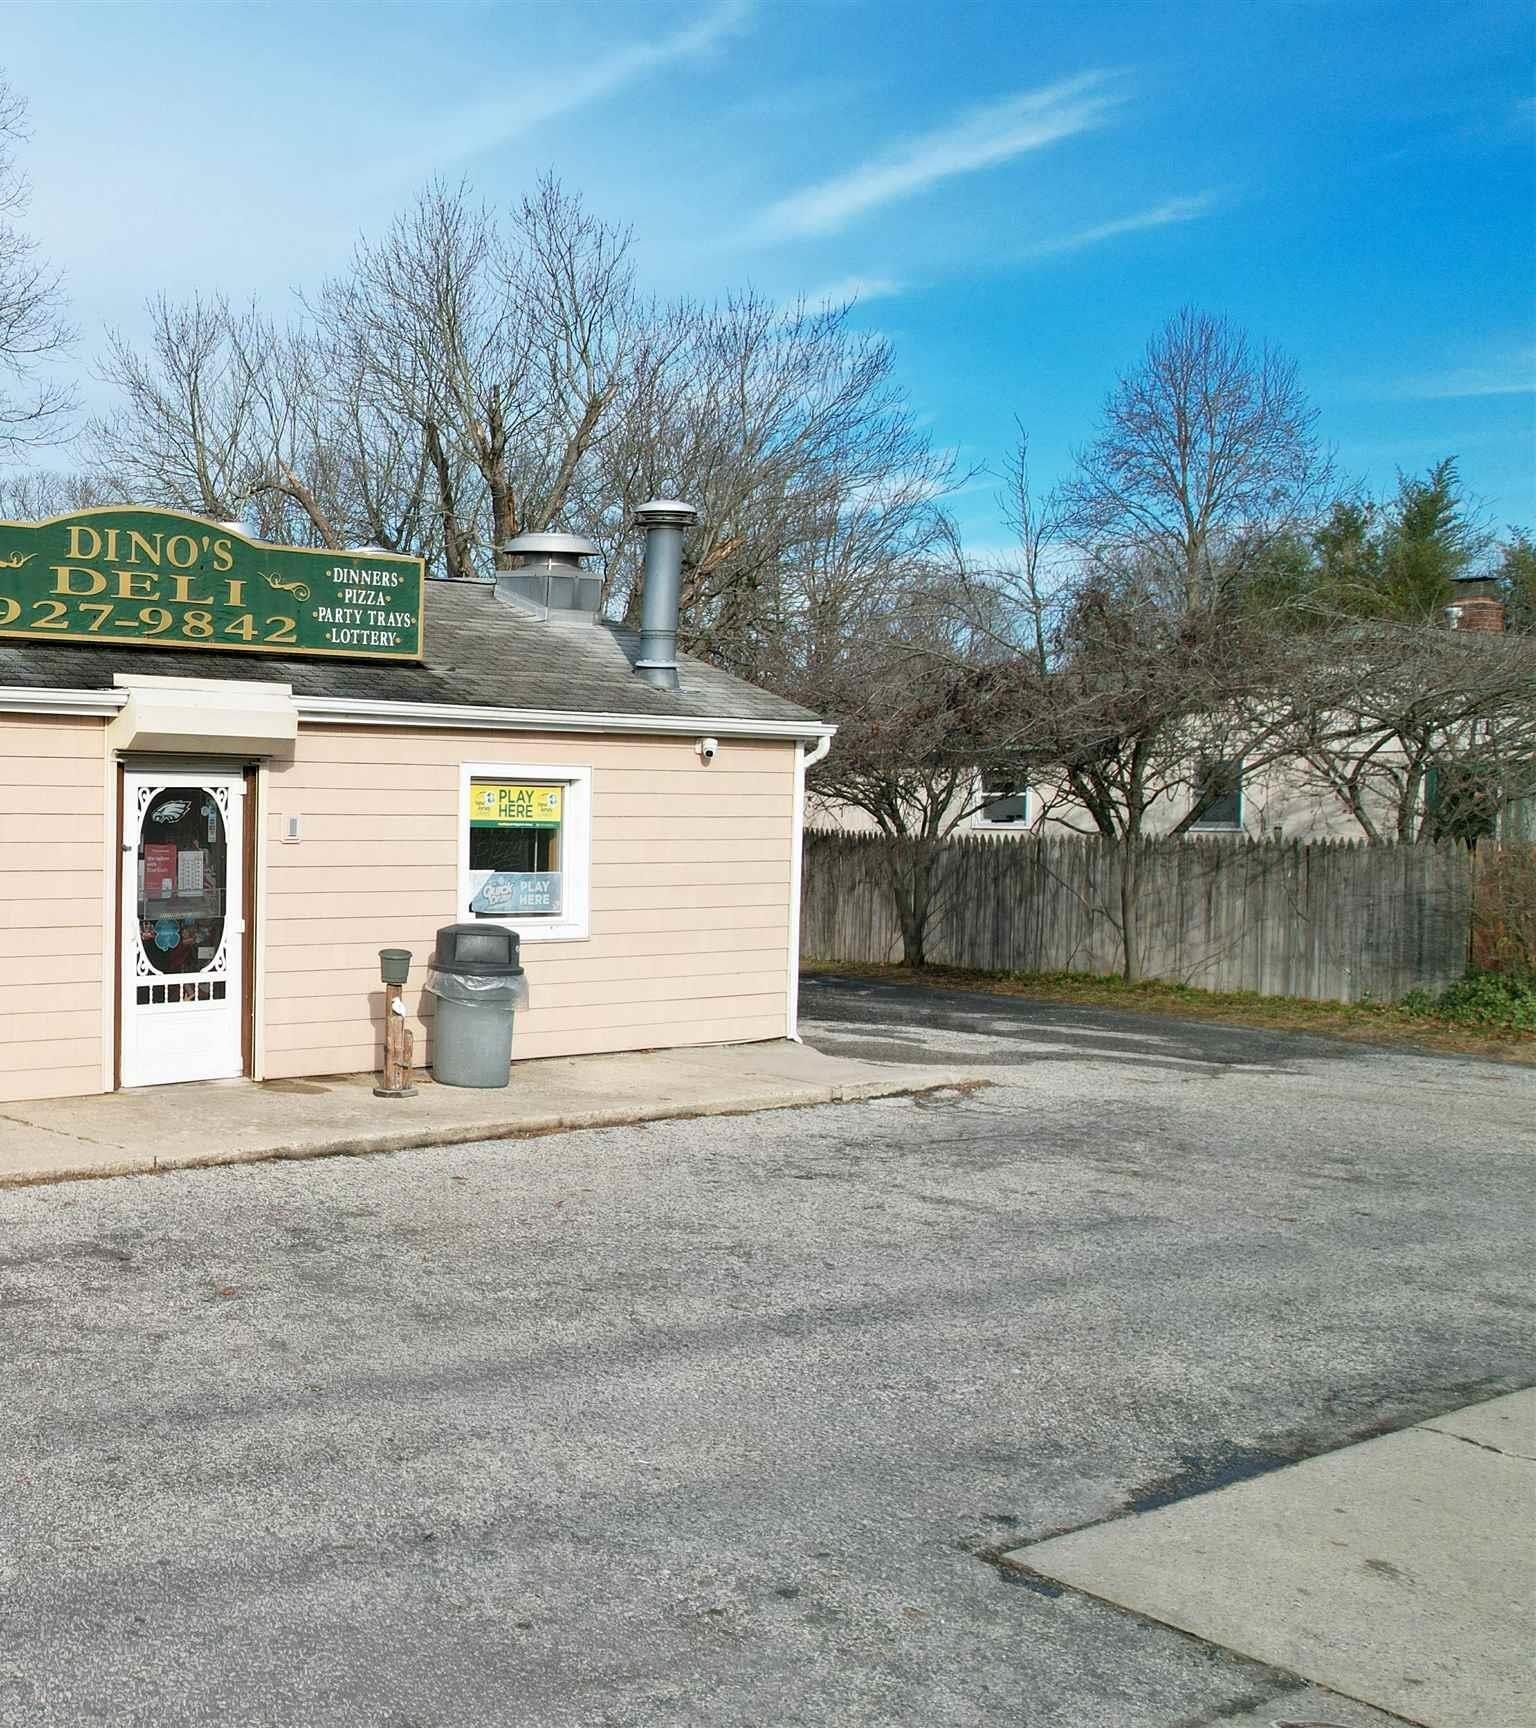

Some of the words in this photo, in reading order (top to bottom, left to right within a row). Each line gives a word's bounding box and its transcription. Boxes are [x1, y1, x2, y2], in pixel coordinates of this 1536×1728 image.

[65, 526, 234, 571] DINO'S
[333, 567, 398, 587] DINNERS
[49, 566, 247, 607] DELI
[344, 588, 385, 606] PIZZA
[318, 606, 363, 624] PARTY
[368, 610, 411, 628] TRAYS
[331, 628, 397, 646] LOTTERY
[498, 789, 534, 804] PLAY
[498, 804, 533, 818] HERE
[520, 881, 550, 893] PLAY
[519, 894, 550, 905] HERE
